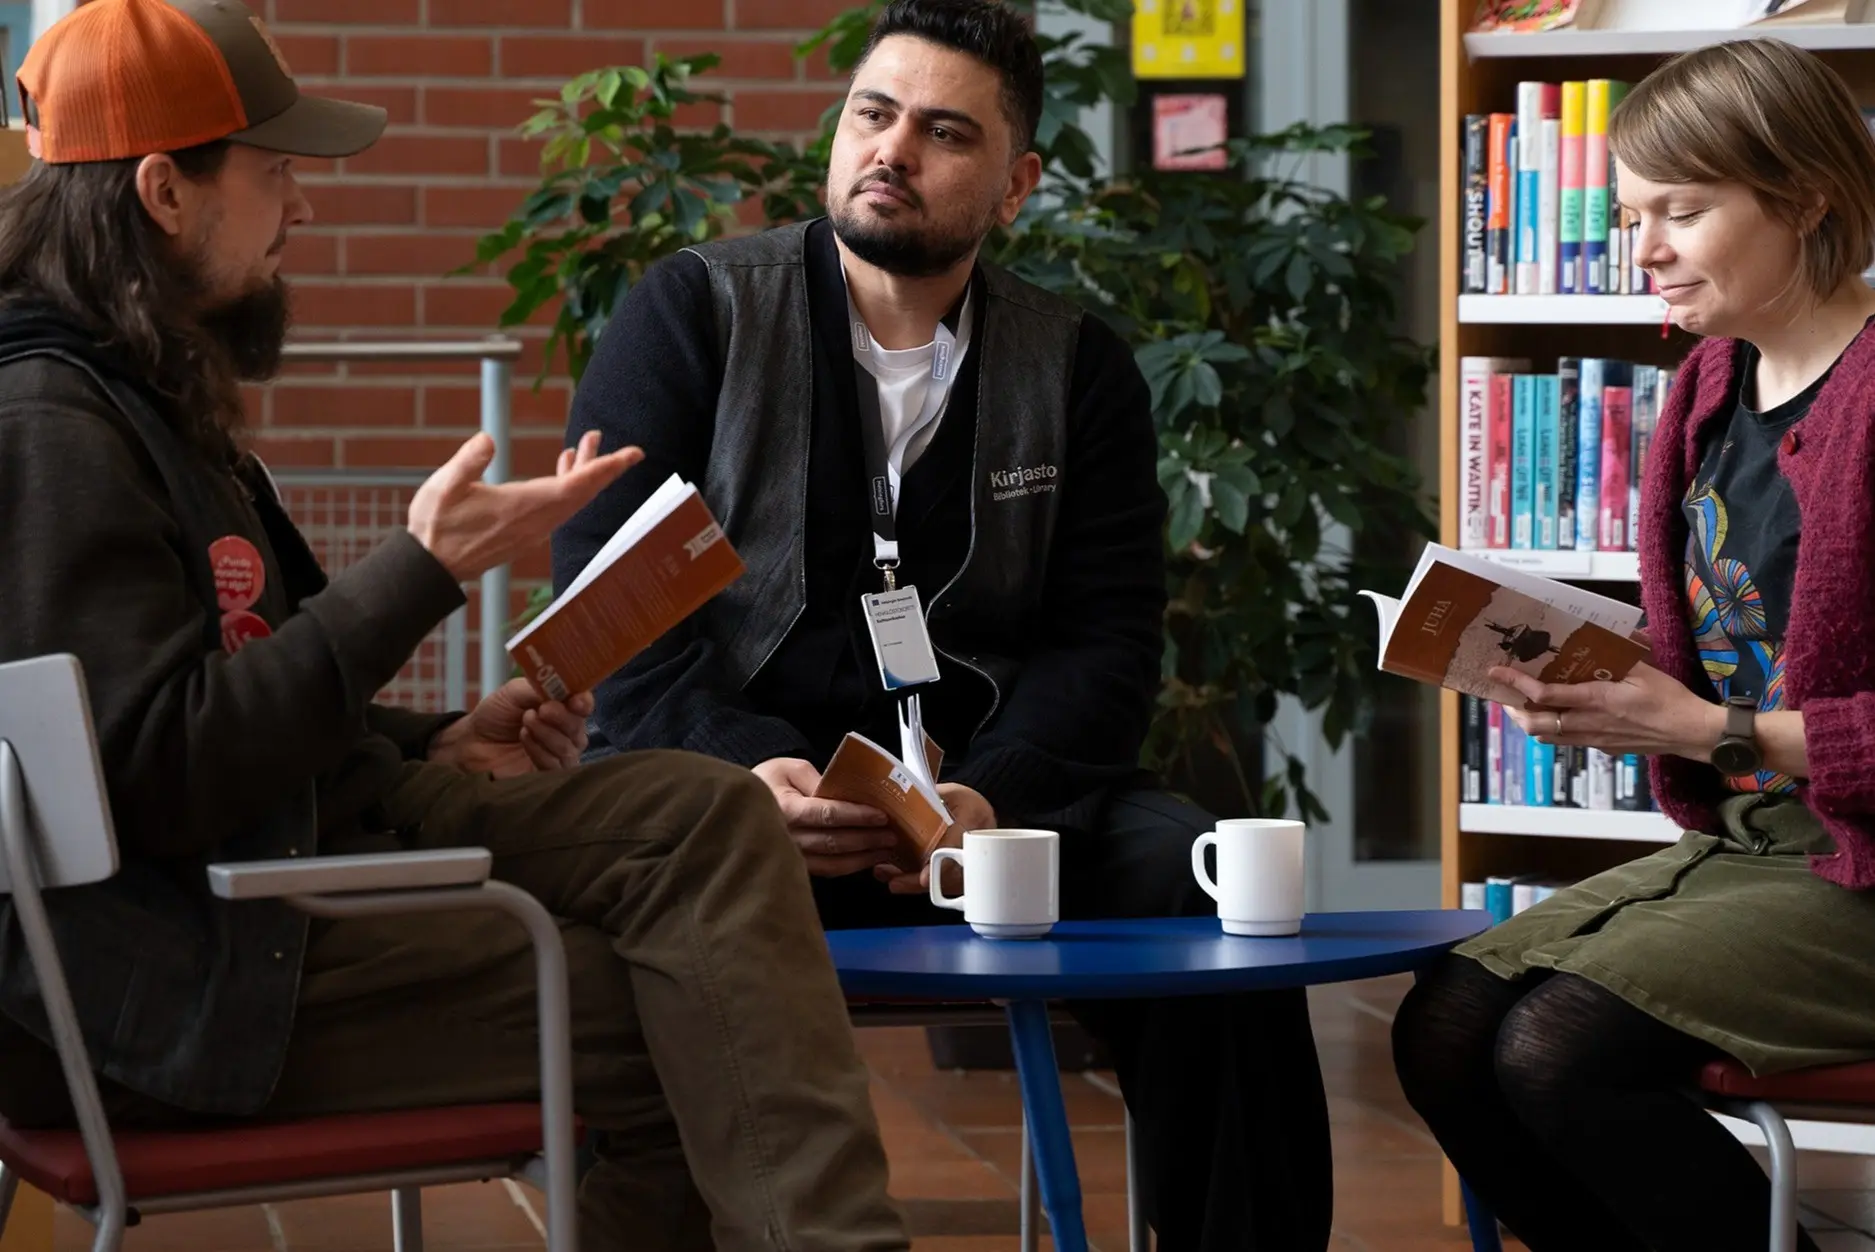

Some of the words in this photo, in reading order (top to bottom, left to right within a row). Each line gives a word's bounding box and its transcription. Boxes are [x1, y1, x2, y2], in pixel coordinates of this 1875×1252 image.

[1468, 390, 1482, 430] KATE
[1468, 435, 1482, 451] IN
[990, 463, 1057, 488] Kirjasto
[993, 487, 1029, 501] Bibliotek
[1033, 484, 1057, 493] Library
[1467, 456, 1482, 527] WAITIN
[1421, 600, 1452, 636] JUHA
